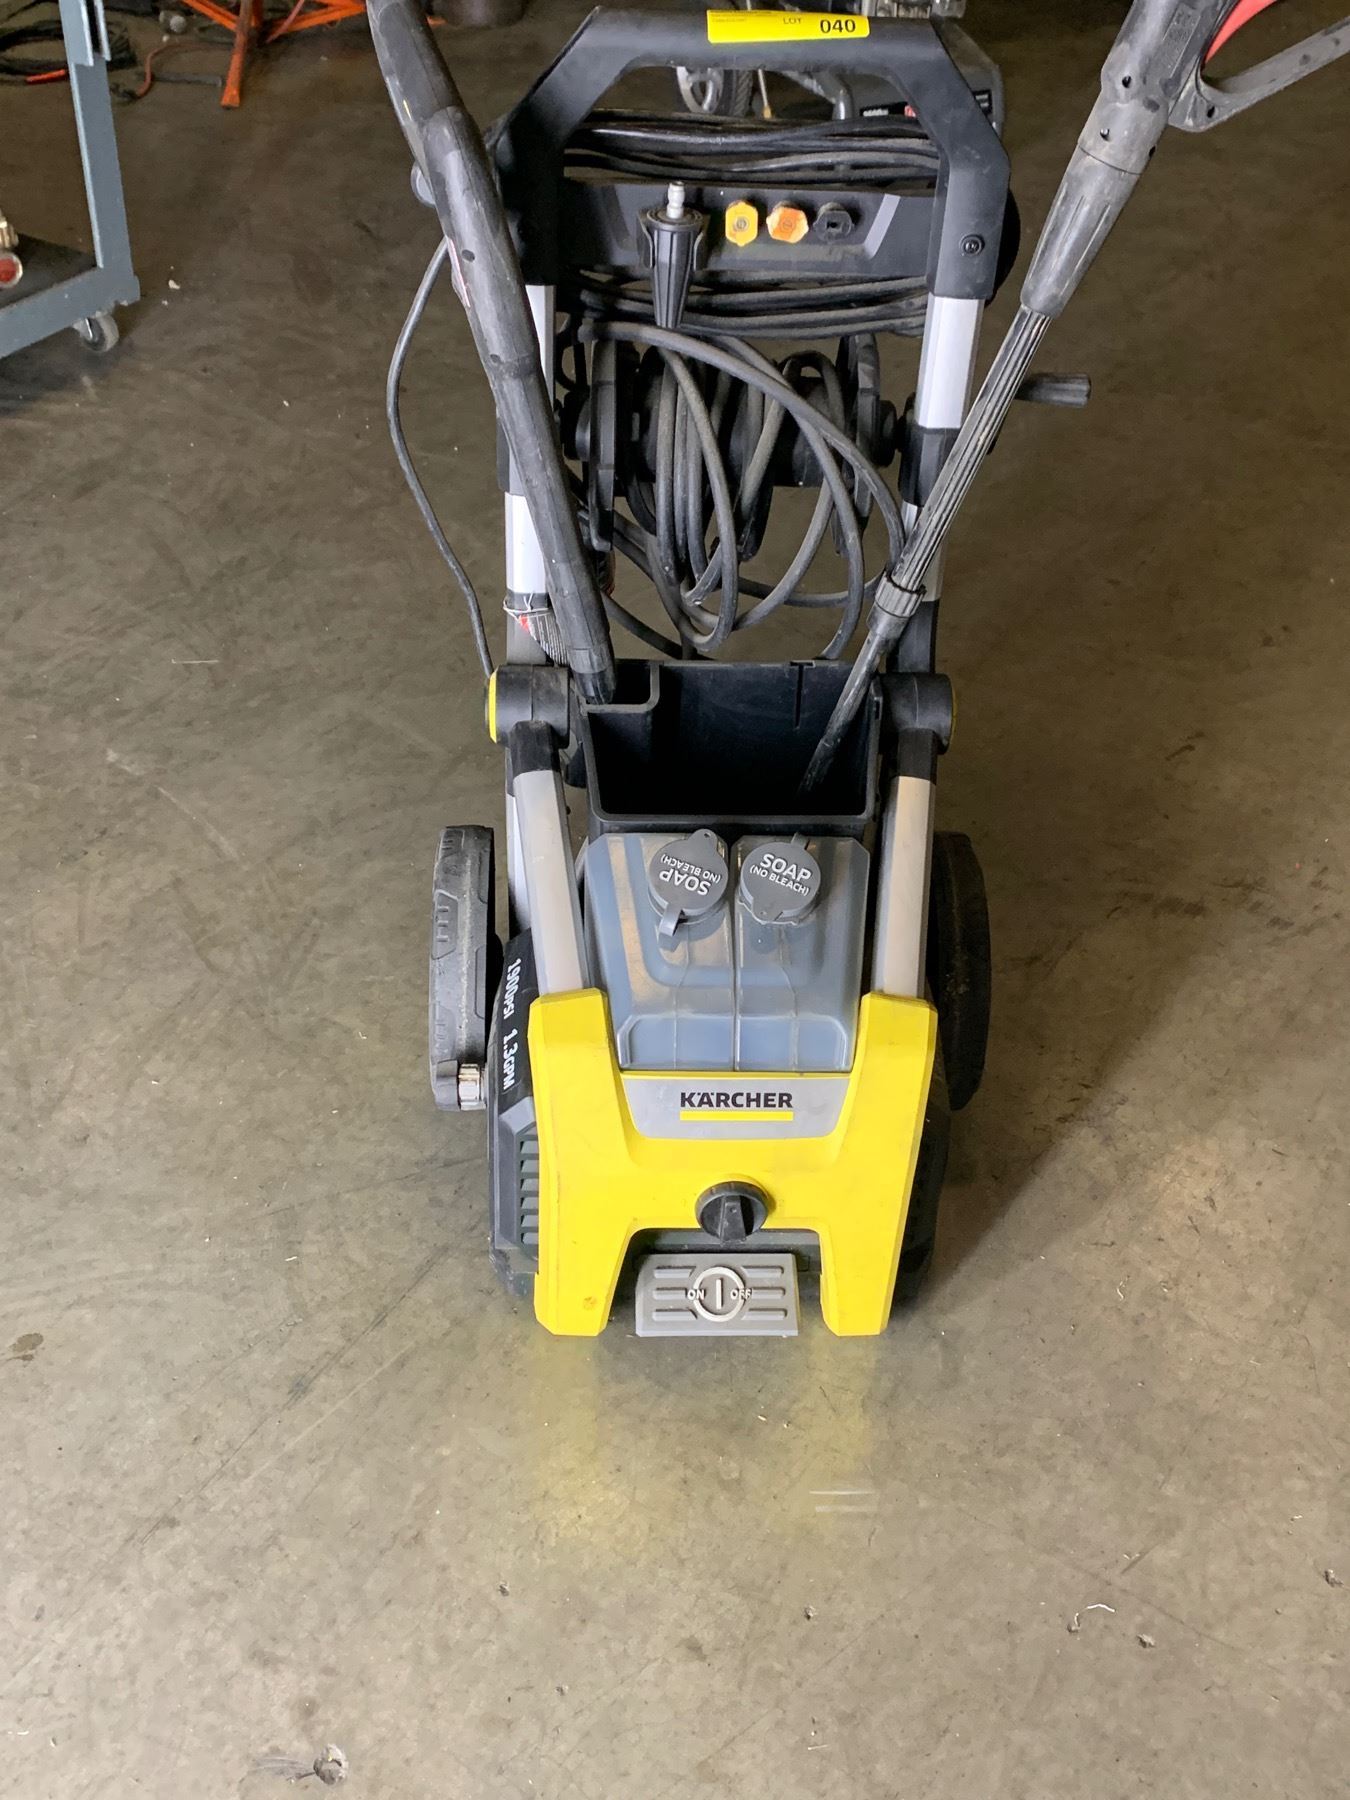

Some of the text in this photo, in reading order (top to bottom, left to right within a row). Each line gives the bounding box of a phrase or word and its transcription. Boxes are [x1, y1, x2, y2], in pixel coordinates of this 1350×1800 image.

[783, 17, 856, 34] LOT 040
[659, 868, 712, 896] SOAP
[660, 853, 722, 884] (NO BLEACH)
[749, 864, 811, 897] (NO BLEACH)
[759, 853, 812, 883] SOAP
[503, 958, 522, 1091] 1900PSI 1.3GPM
[680, 1092, 793, 1109] KÄRCHER
[687, 1289, 706, 1301] ON
[730, 1289, 752, 1301] OFF
